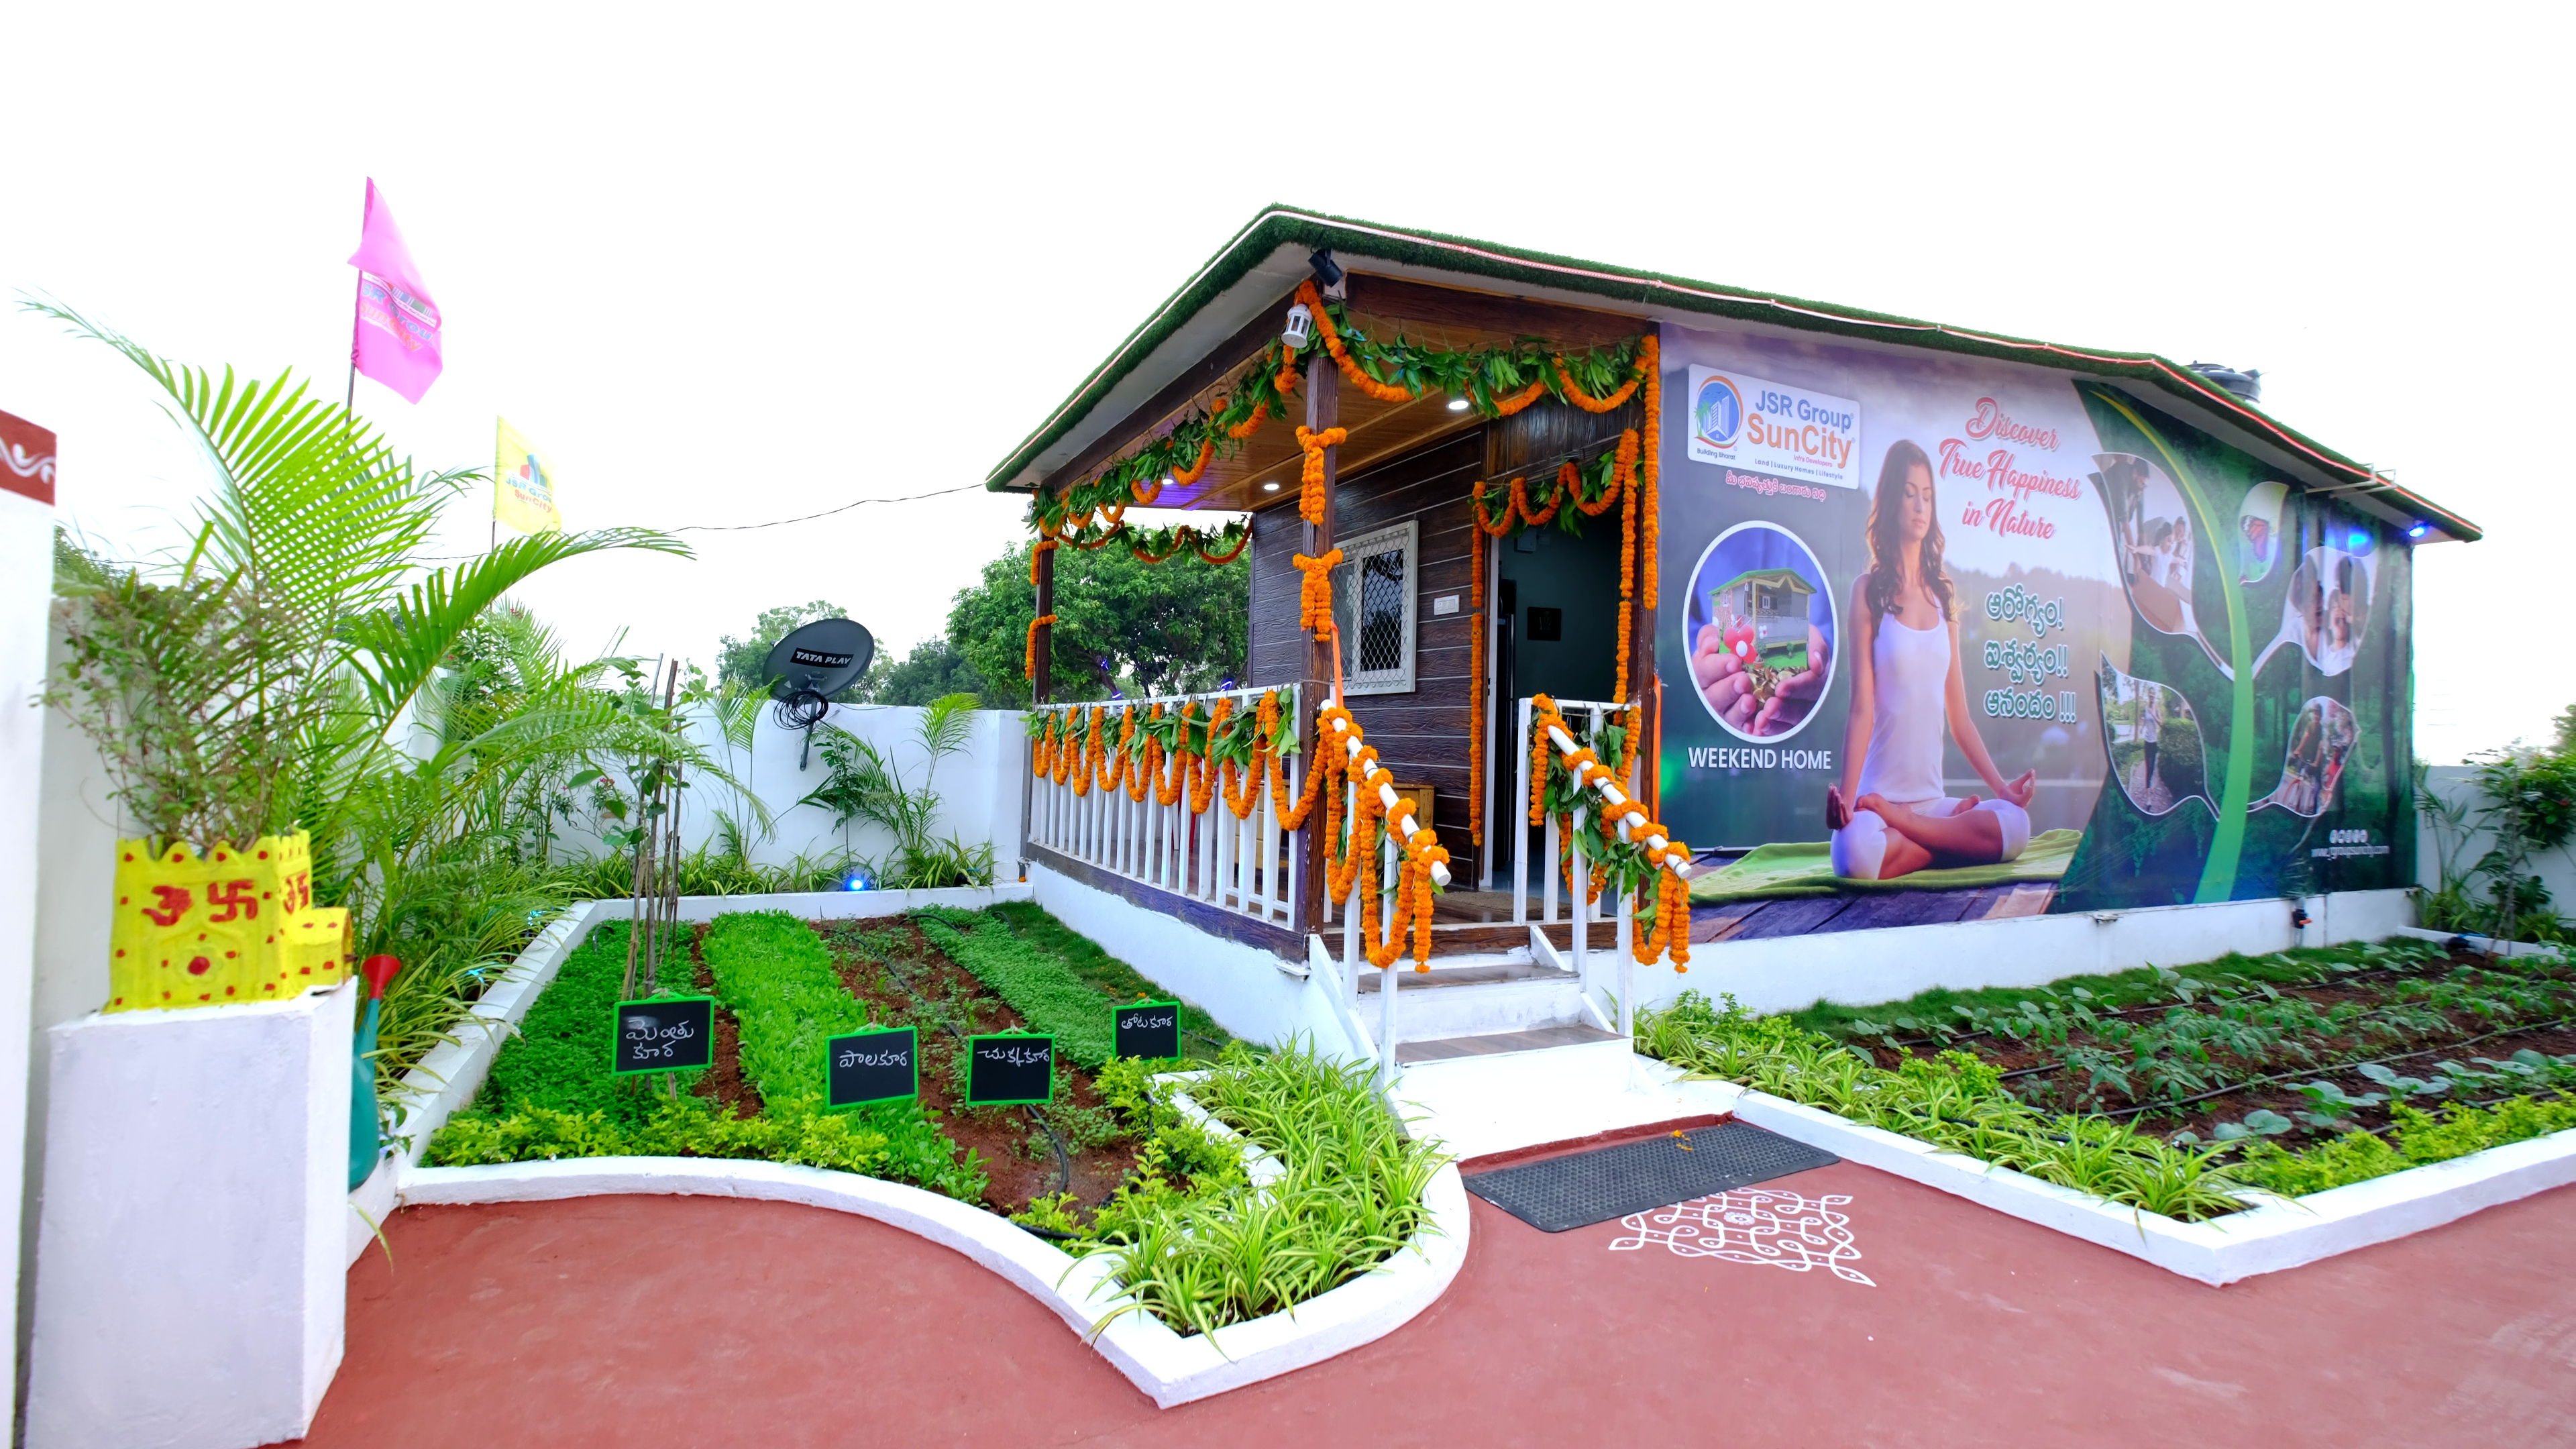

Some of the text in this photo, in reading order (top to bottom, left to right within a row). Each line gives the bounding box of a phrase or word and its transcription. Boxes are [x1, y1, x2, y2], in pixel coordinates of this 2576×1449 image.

[362, 282, 386, 303] SR
[1755, 390, 1851, 434] JSR Group
[1965, 396, 2060, 451] Discover
[1747, 413, 1851, 469] SunCity
[1697, 447, 1736, 461] Building Bharat
[1793, 454, 1833, 468] Infra Developers
[1755, 458, 1769, 467] Land
[1774, 462, 1793, 472] Luxury
[1794, 466, 1815, 475] Homes
[1819, 470, 1843, 480] Lifestyle
[1939, 438, 2082, 500] True Happiness
[506, 477, 527, 490] JSR
[1779, 484, 1811, 498] బంగారు
[514, 488, 552, 514] SunCity
[1962, 498, 2055, 539] in Nature
[796, 651, 851, 665] TATA PLAY
[1688, 747, 1831, 769] WEEKEND HOME
